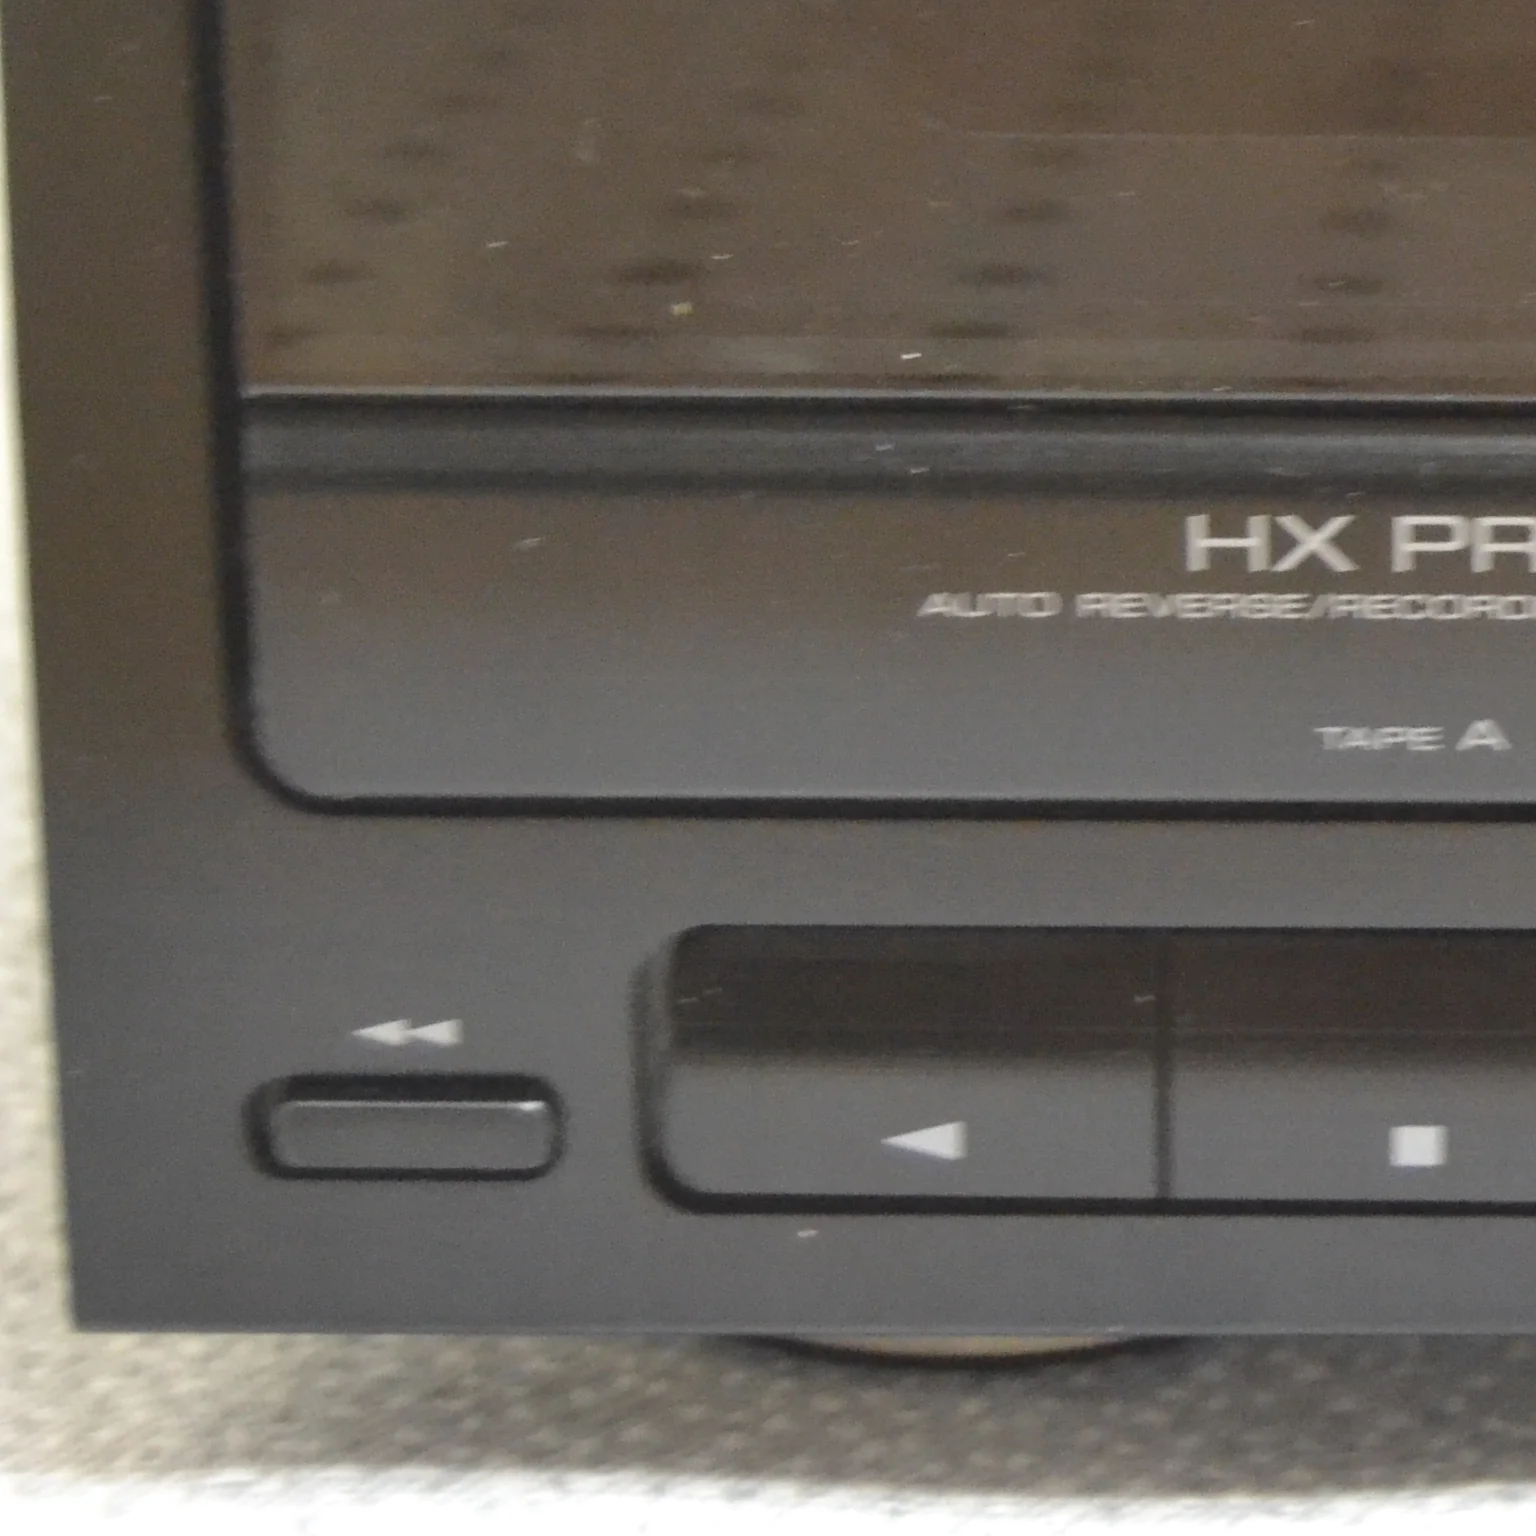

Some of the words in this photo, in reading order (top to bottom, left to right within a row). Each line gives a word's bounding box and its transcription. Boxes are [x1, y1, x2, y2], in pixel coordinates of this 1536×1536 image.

[1182, 515, 1359, 573] HX
[917, 592, 1061, 618] AUTO
[1312, 724, 1446, 751] TAPE
[1454, 719, 1513, 752] A
